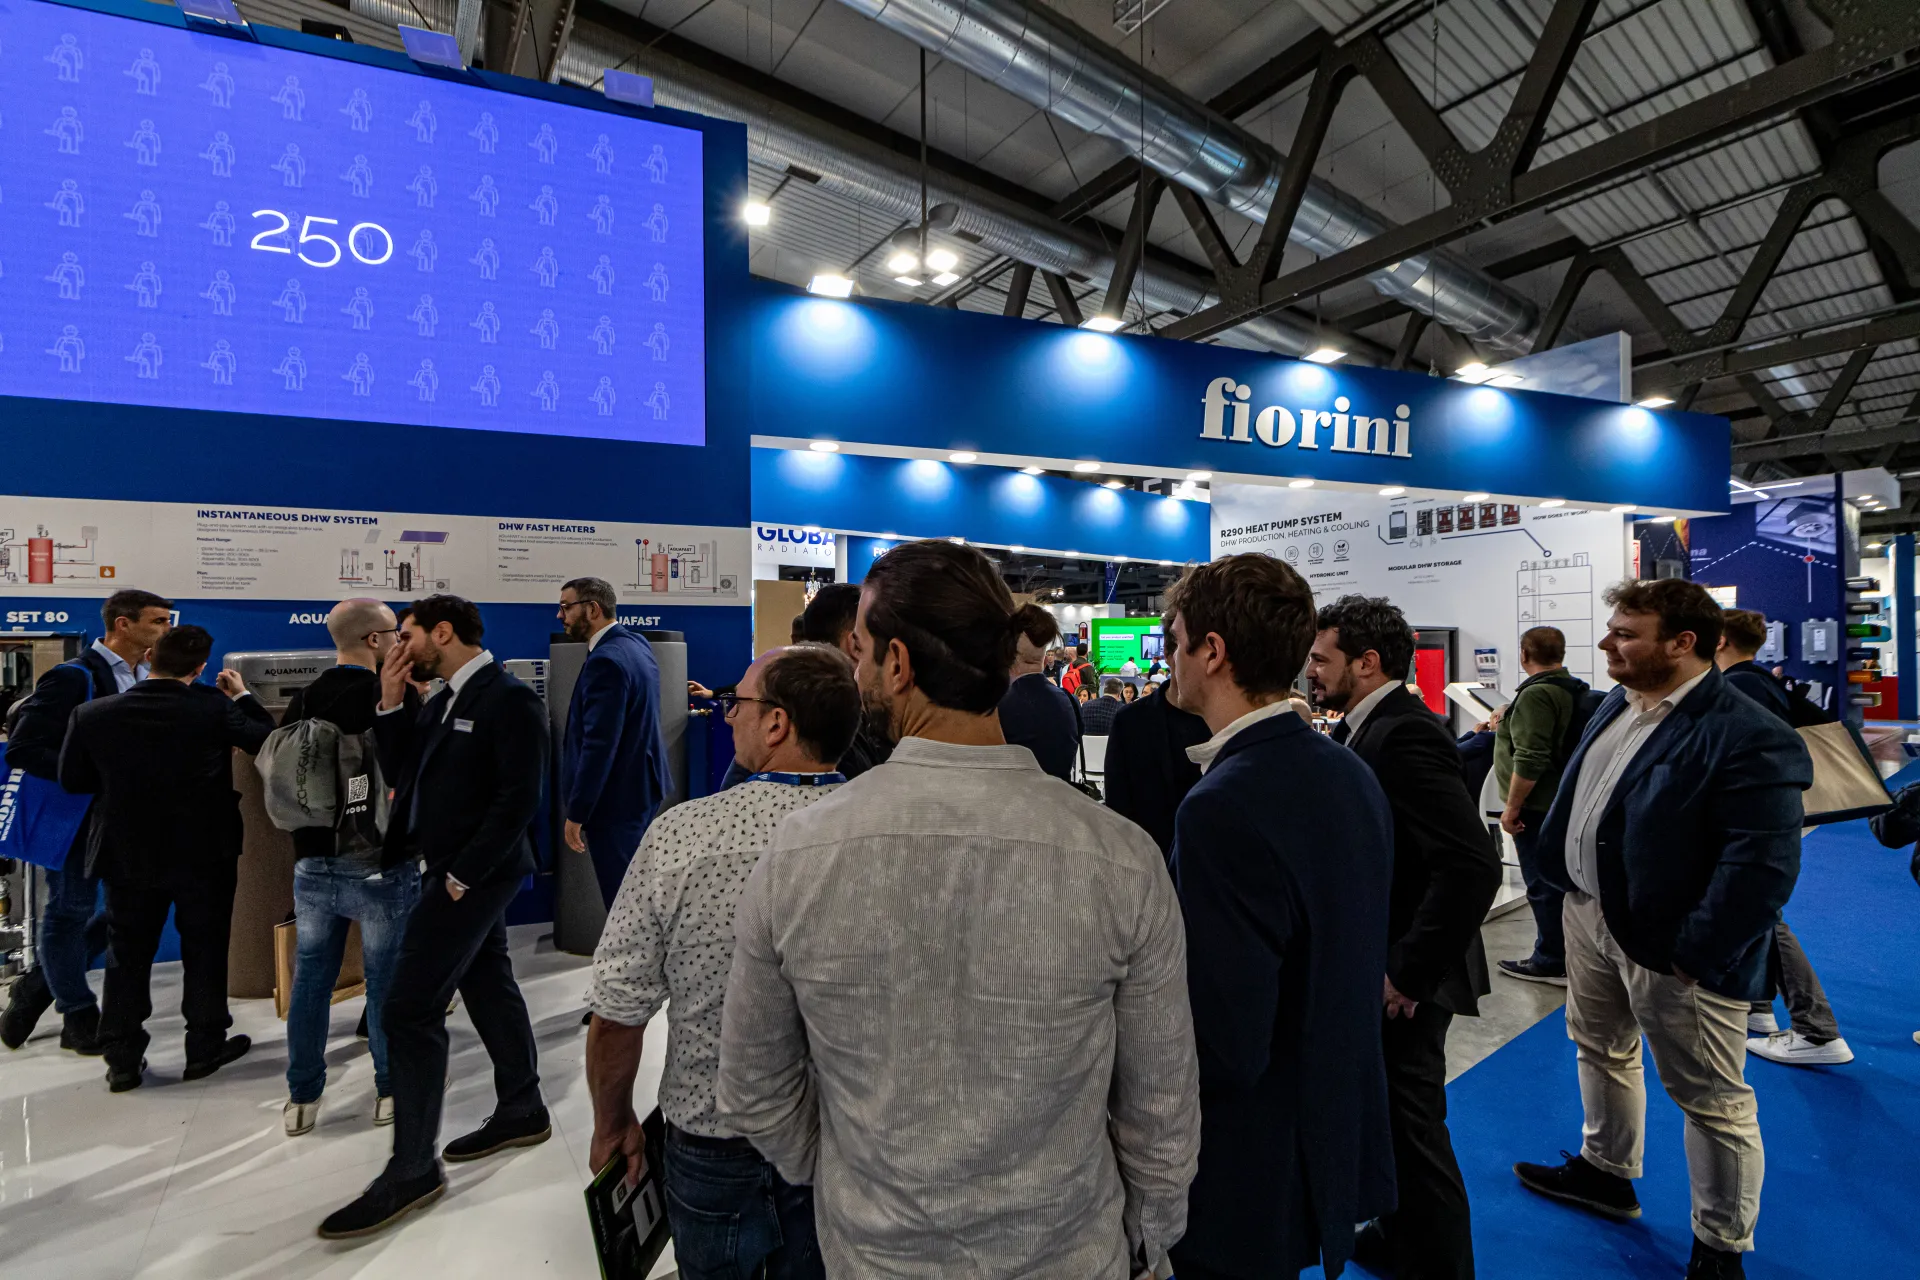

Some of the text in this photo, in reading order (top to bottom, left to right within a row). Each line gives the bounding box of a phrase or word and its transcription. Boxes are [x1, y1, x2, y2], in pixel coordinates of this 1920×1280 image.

[251, 209, 393, 268] 250
[1200, 376, 1412, 458] fiorini
[197, 510, 378, 525] INSTANTANEOUS DHW SYSTEM
[498, 522, 596, 534] DHW FAST HEATERS
[1221, 512, 1342, 538] R290 HEAT PUMP SYSTEM
[1220, 538, 1238, 547] DHW
[1289, 526, 1322, 538] HEATING
[1330, 520, 1370, 532] COOLING
[1433, 560, 1462, 568] STORAGE
[1309, 571, 1335, 579] HYDRONIC
[6, 611, 69, 623] SET 80
[264, 667, 318, 676] AQUAMATIC
